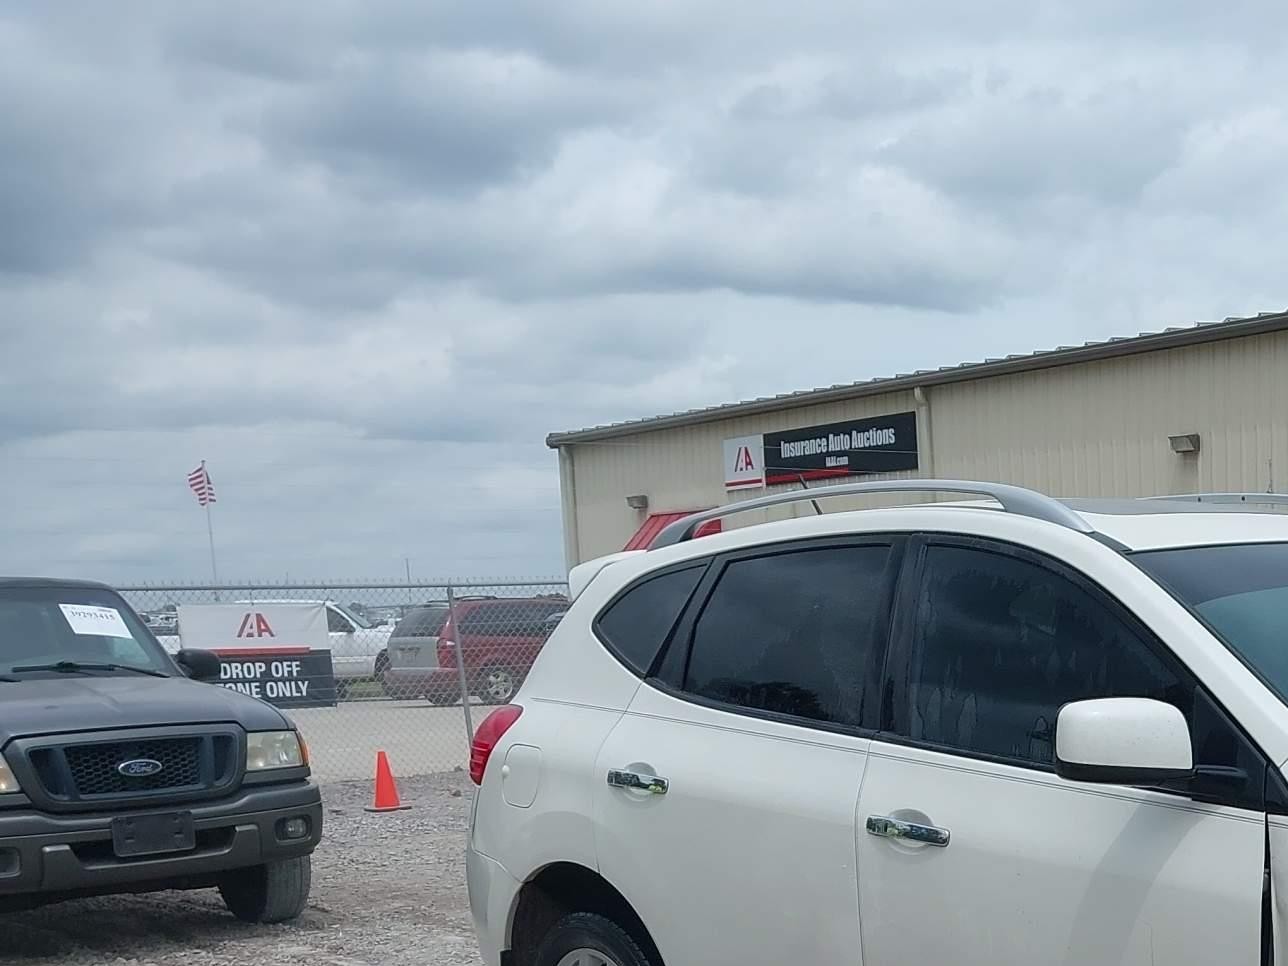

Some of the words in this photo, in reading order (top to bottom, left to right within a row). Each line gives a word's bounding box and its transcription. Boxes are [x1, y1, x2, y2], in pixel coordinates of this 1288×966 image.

[780, 437, 827, 459] Insurance
[828, 432, 851, 452] Auto
[851, 427, 896, 450] Auctions
[220, 662, 266, 680] DROP
[271, 661, 301, 678] OFF
[266, 680, 310, 698] ONLY
